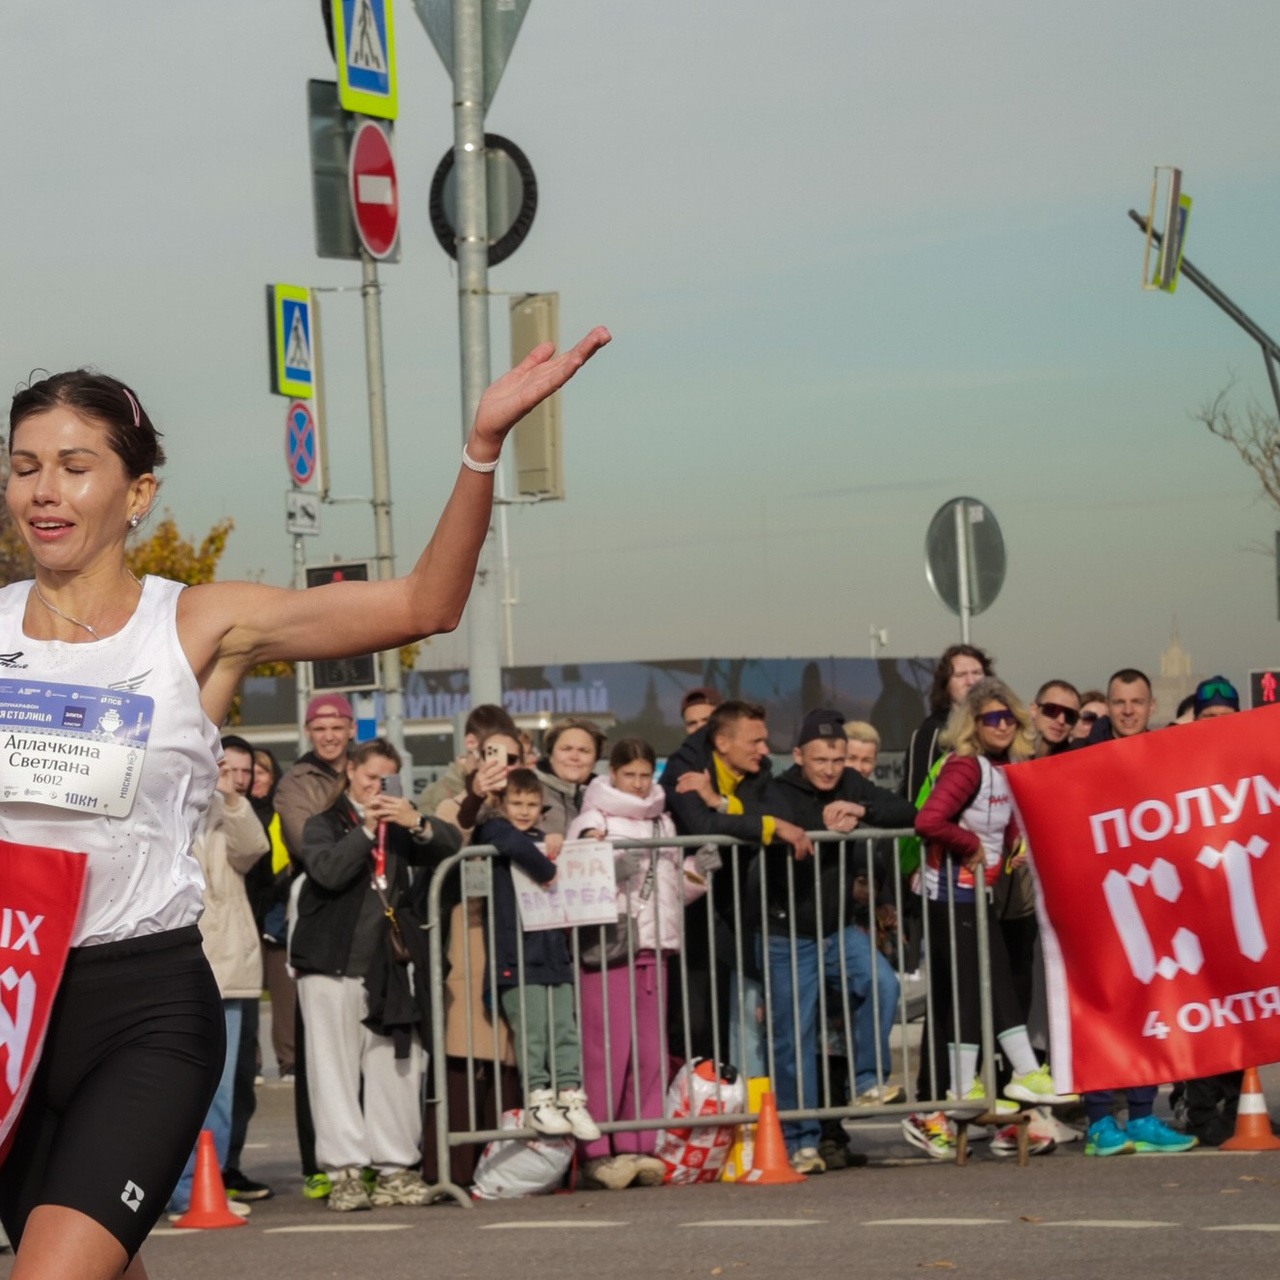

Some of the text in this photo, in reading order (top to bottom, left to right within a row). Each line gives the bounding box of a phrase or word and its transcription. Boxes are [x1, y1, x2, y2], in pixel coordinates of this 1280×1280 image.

[7, 710, 53, 723] СТОЛИЦА
[4, 734, 101, 760] Аплачкина
[8, 751, 90, 776] Светлана
[31, 773, 63, 787] 16012
[119, 765, 134, 799] МОСКВА
[1141, 1009, 1172, 1040] 4
